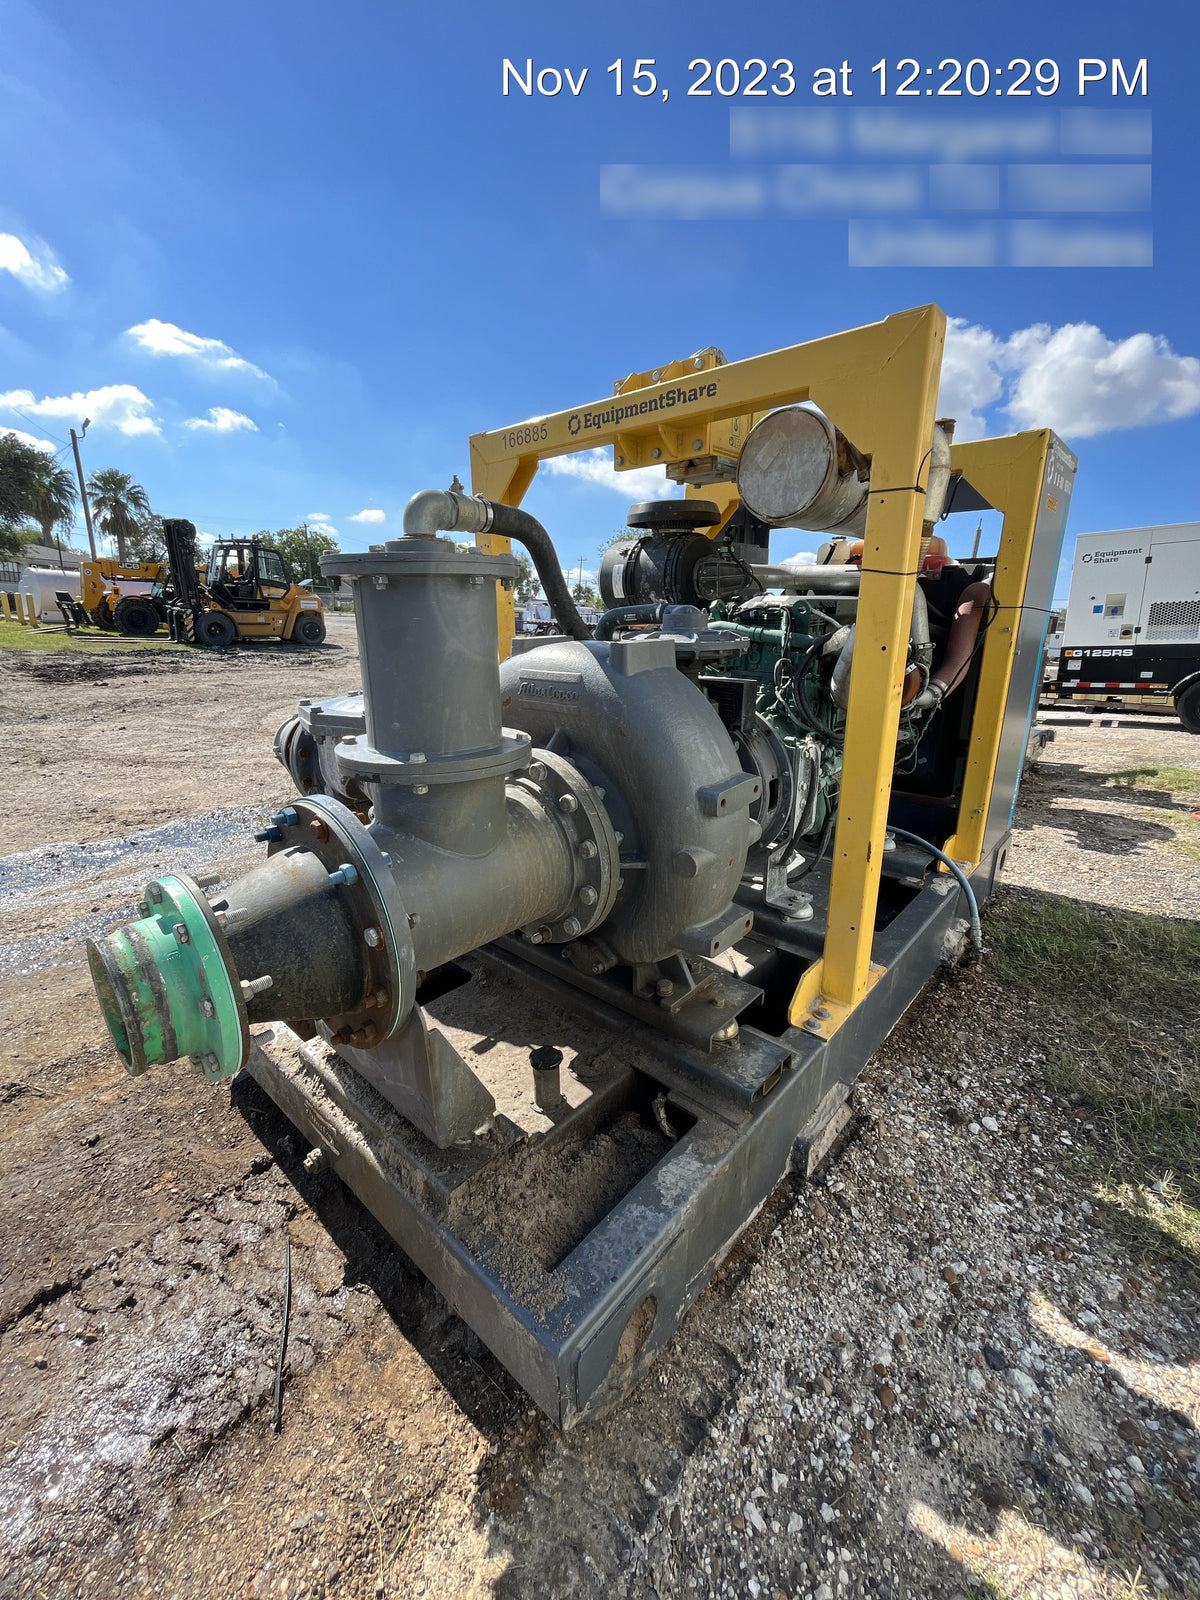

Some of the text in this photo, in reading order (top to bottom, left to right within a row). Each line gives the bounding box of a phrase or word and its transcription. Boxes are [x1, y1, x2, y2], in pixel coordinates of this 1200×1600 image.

[583, 381, 718, 430] EquipmentShare
[501, 423, 549, 449] 166885
[1094, 547, 1143, 558] Equipment
[1093, 556, 1119, 564] Share
[119, 562, 140, 570] JCB
[1072, 648, 1134, 657] G125RS
